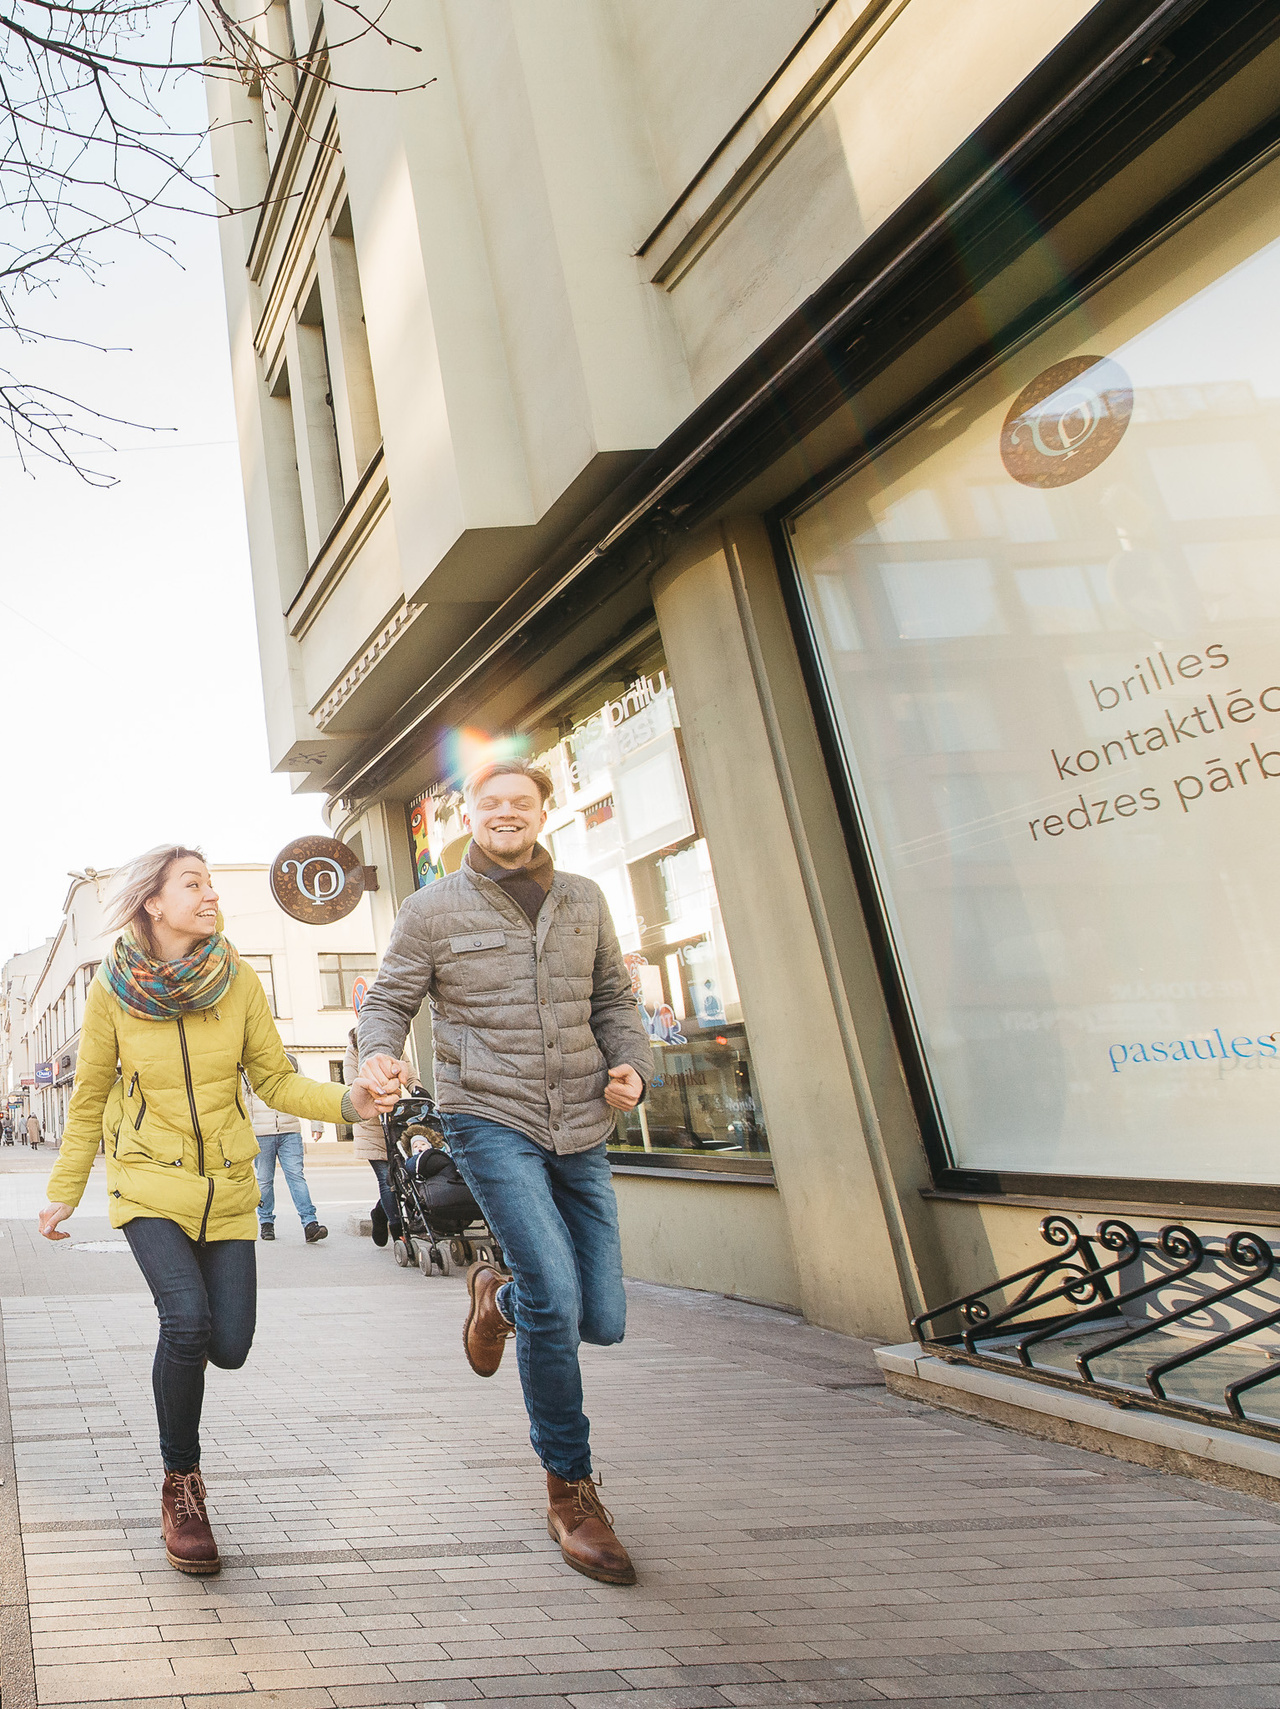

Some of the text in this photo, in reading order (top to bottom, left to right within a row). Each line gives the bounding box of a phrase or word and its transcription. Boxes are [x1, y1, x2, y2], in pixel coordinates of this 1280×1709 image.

[604, 670, 668, 726] brillu
[1089, 643, 1230, 712] brilles
[1051, 686, 1280, 781] kontaktlēc
[1028, 742, 1280, 841] redzes pārb
[1108, 1028, 1278, 1073] pasaules
